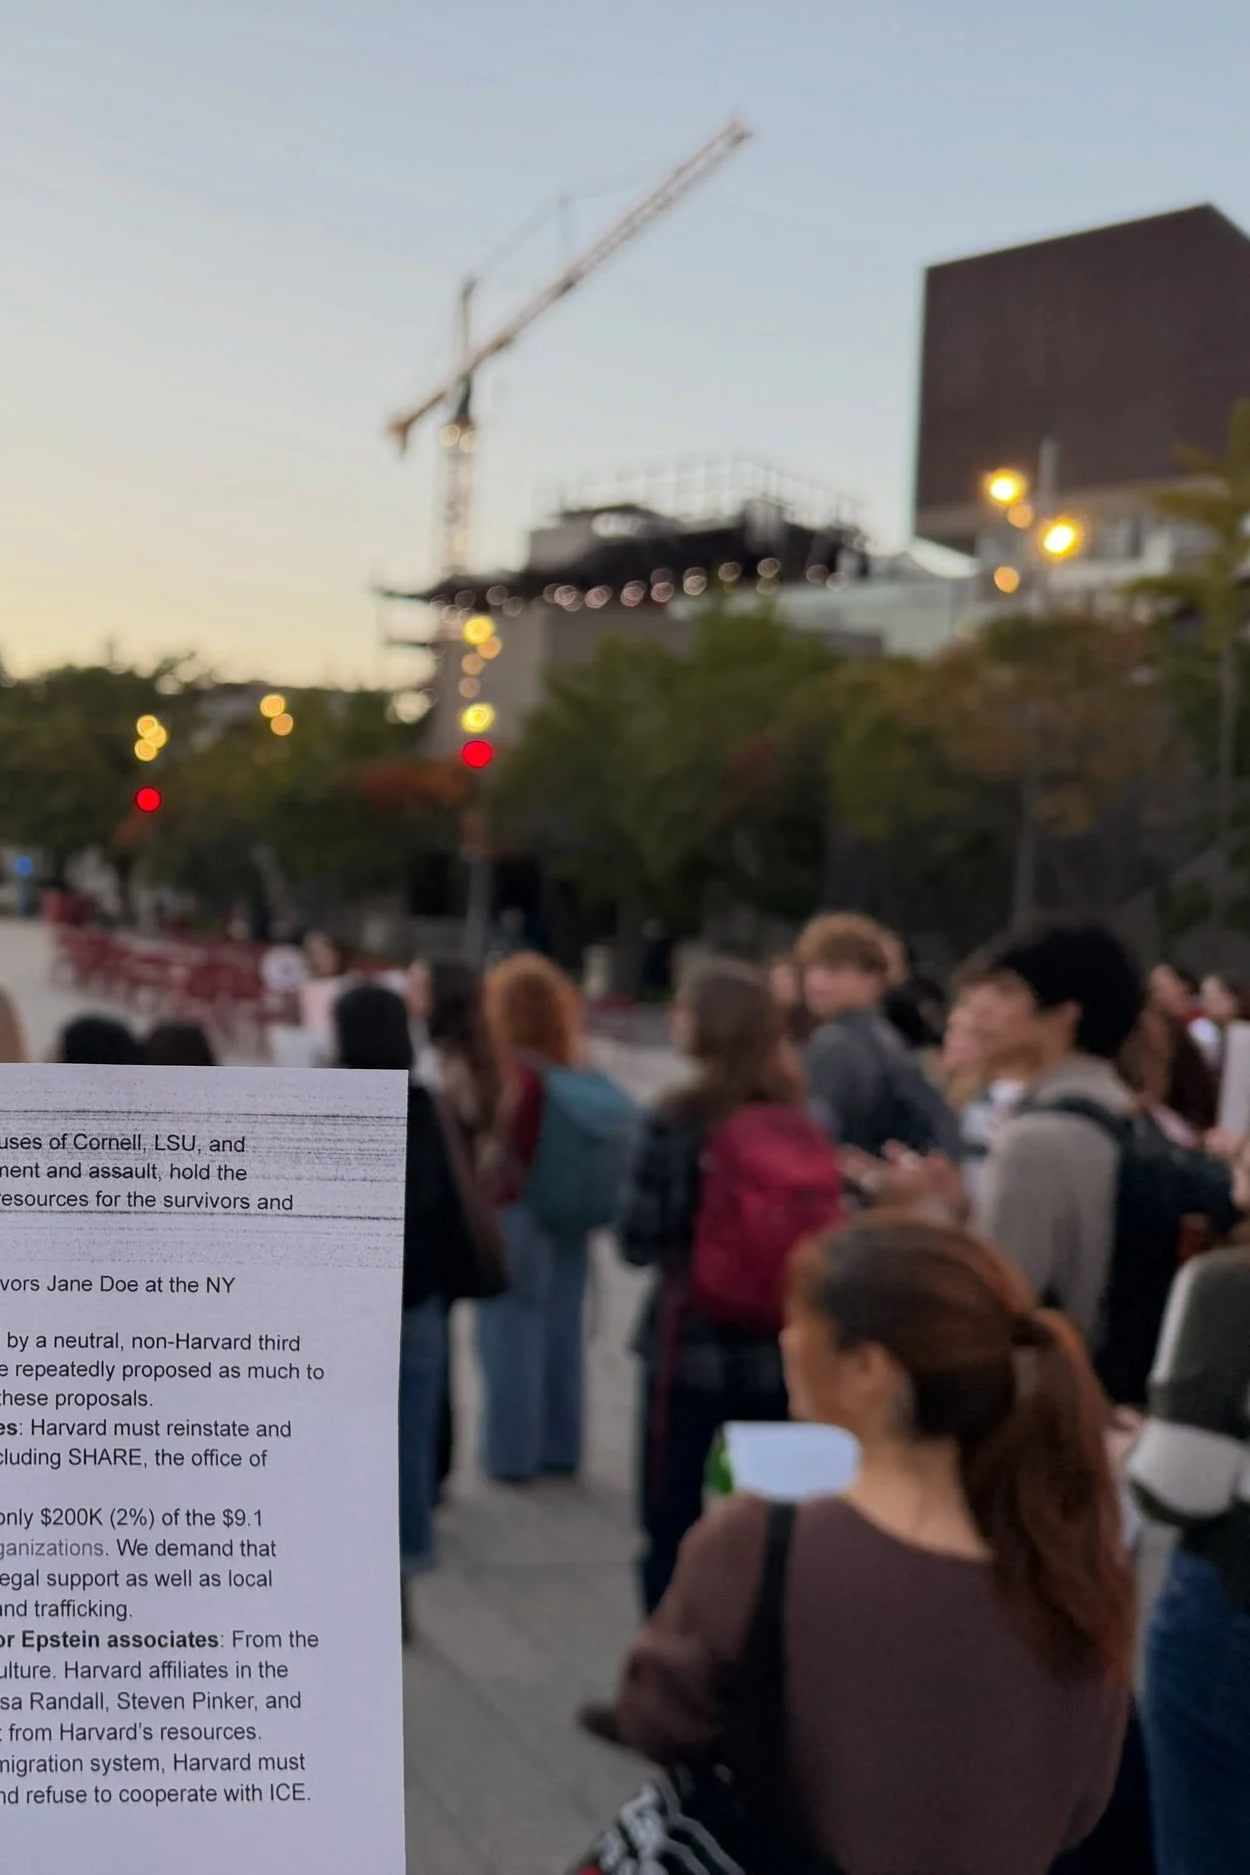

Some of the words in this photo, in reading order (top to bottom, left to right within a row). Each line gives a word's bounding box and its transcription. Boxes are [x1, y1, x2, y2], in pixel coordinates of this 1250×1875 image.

[48, 1132, 68, 1149] of
[73, 1133, 146, 1152] Cornell,
[154, 1133, 201, 1153] LSU,
[209, 1135, 245, 1152] and
[46, 1275, 93, 1291] Jane
[100, 1274, 138, 1292] Doe
[145, 1276, 163, 1292] at
[169, 1276, 199, 1292] the
[206, 1276, 235, 1293] NY
[7, 1331, 29, 1352] by
[35, 1335, 46, 1348] a
[54, 1332, 123, 1350] neutral,
[132, 1333, 251, 1349] non-Harvard
[258, 1334, 300, 1351] third
[31, 1418, 106, 1435] Harvard
[114, 1420, 160, 1436] must
[166, 1419, 249, 1436] reinstate
[256, 1420, 291, 1437] and
[40, 1507, 103, 1525] $200K
[110, 1507, 154, 1529] (2%)
[161, 1507, 180, 1526] of
[185, 1508, 215, 1526] the
[222, 1508, 261, 1527] $9.1
[34, 1599, 132, 1621] trafficking.
[21, 1629, 99, 1651] Epstein
[107, 1630, 224, 1648] associates:
[232, 1629, 282, 1647] From
[288, 1630, 319, 1647] the
[30, 1691, 109, 1710] Randall,
[117, 1691, 185, 1709] Steven
[192, 1691, 257, 1710] Pinker,
[265, 1691, 301, 1708] and
[90, 1755, 165, 1775] system,
[173, 1752, 251, 1771] Harvard
[258, 1753, 305, 1770] must
